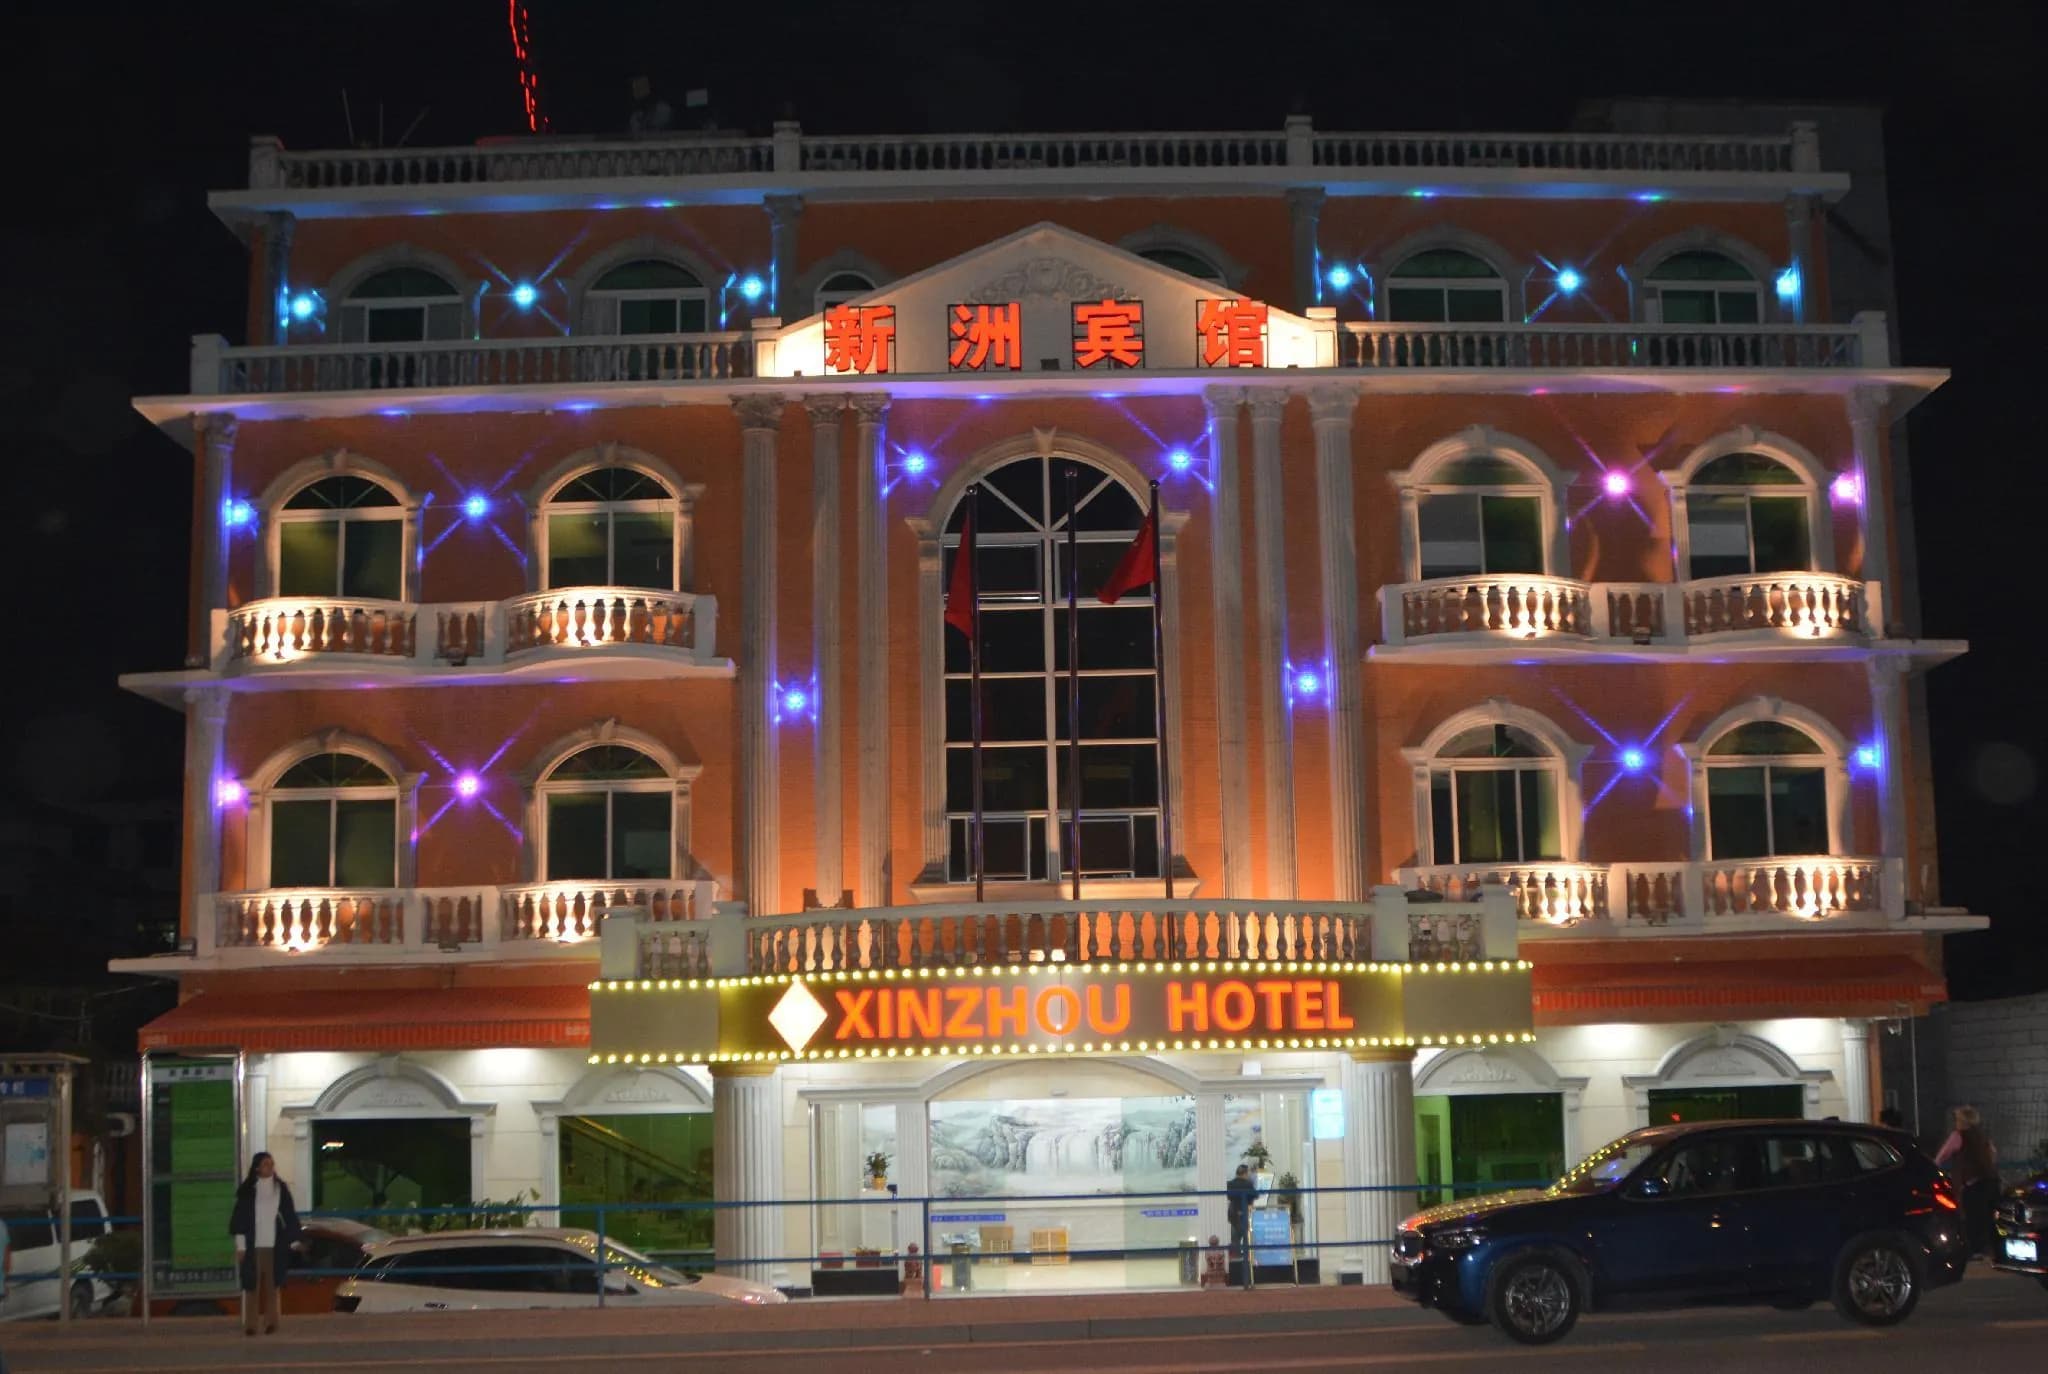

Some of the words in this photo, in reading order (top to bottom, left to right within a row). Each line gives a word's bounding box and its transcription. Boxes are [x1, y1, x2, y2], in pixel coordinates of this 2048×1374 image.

[825, 299, 1269, 373] 新洲宾馆
[835, 983, 1133, 1040] XINZHOU
[1167, 980, 1355, 1033] HOTEL
